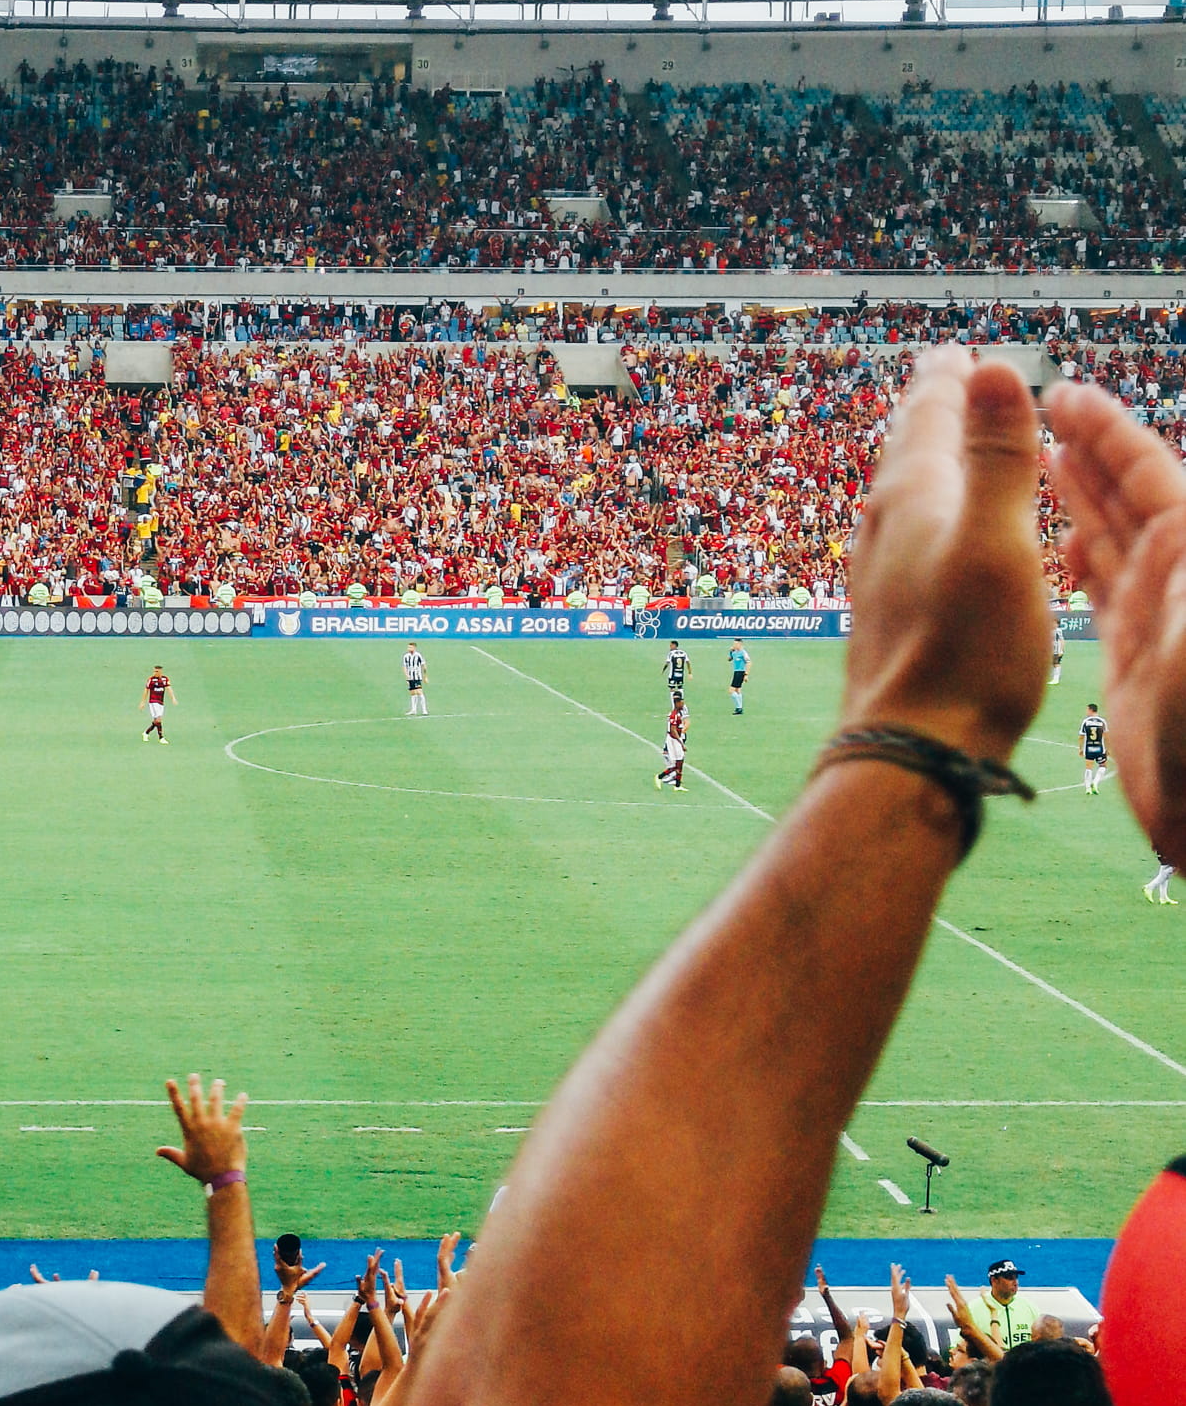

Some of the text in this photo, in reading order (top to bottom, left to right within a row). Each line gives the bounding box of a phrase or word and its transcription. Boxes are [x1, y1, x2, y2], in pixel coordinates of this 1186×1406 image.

[182, 59, 193, 68] 31
[418, 60, 428, 68] 30
[662, 61, 673, 70] 29
[312, 614, 570, 632] BRASILEIRÃO ASSAÍ 2018
[676, 613, 823, 630] O ESTÔMAGO SENTIU?
[1089, 726, 1098, 741] 3
